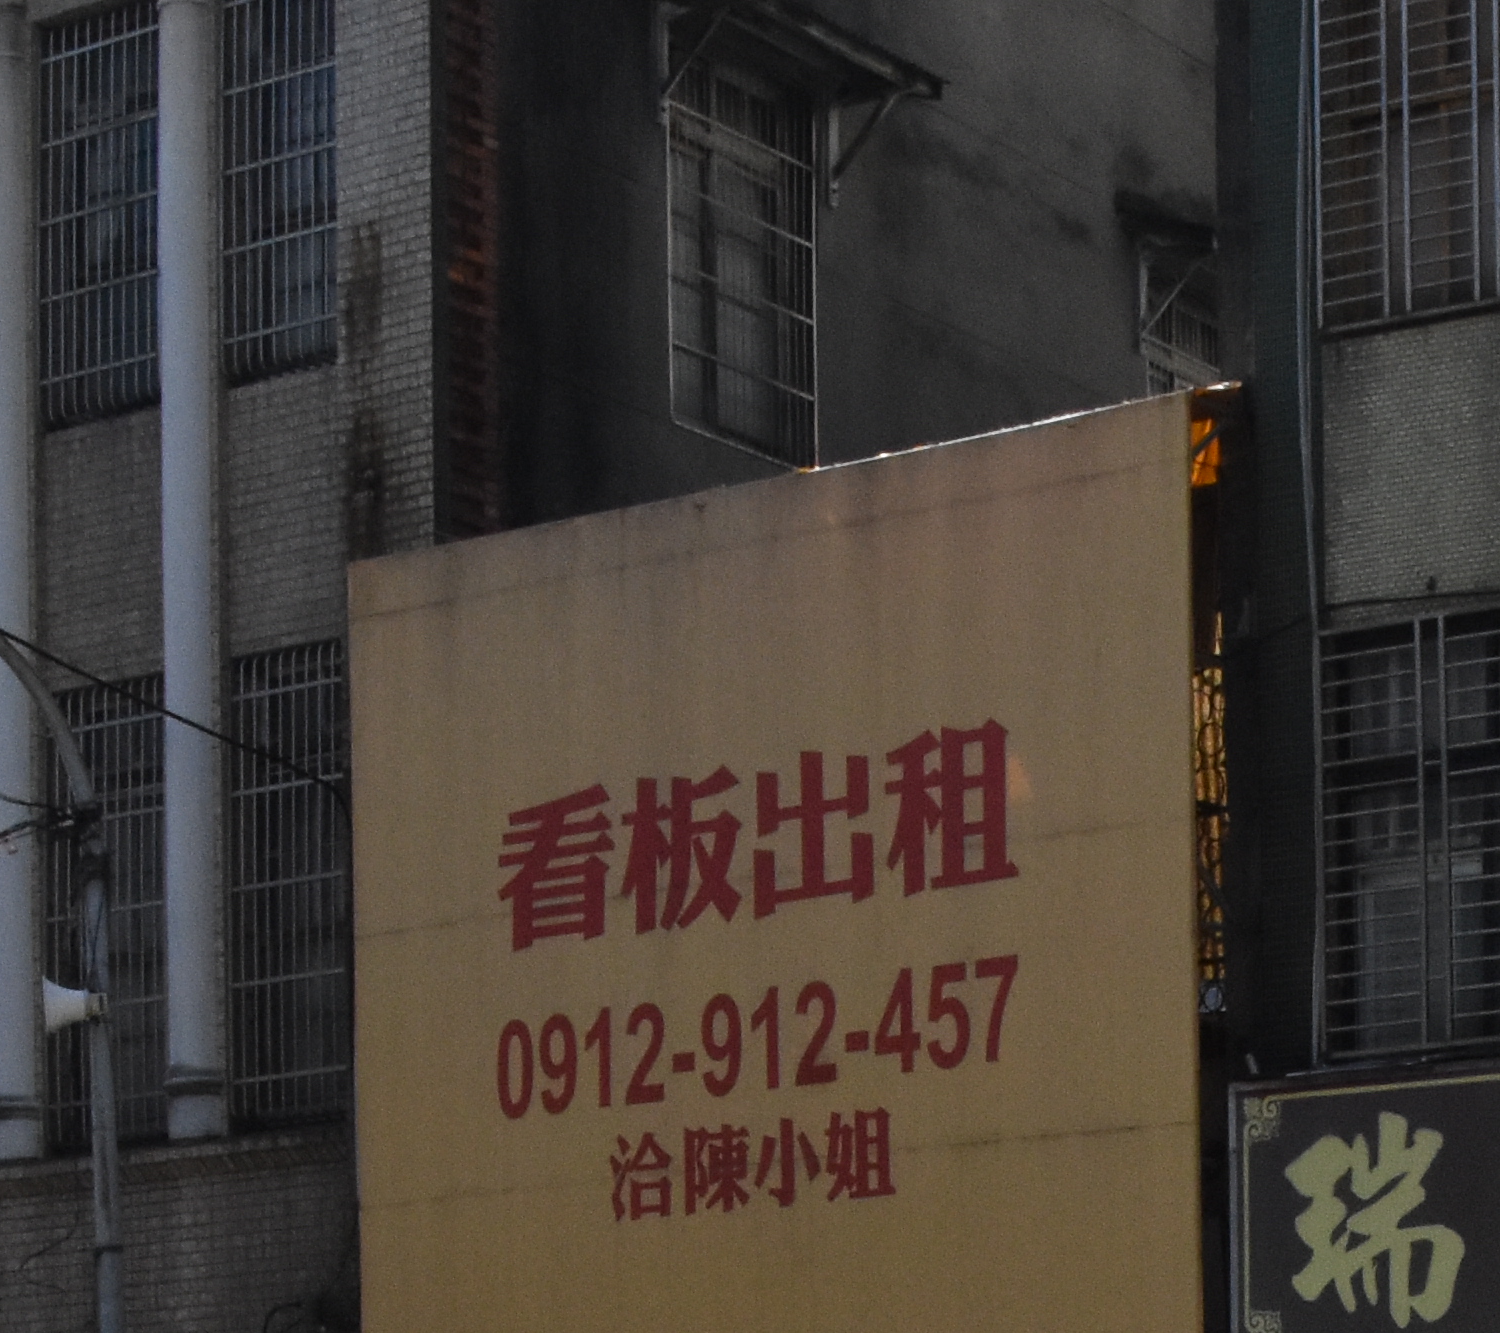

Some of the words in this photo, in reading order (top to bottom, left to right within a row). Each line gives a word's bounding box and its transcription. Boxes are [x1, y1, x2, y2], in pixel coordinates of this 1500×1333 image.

[498, 719, 1020, 951] 看板出租
[496, 955, 1020, 1120] 0912-912-457
[610, 1106, 897, 1222] 洽陳小姐
